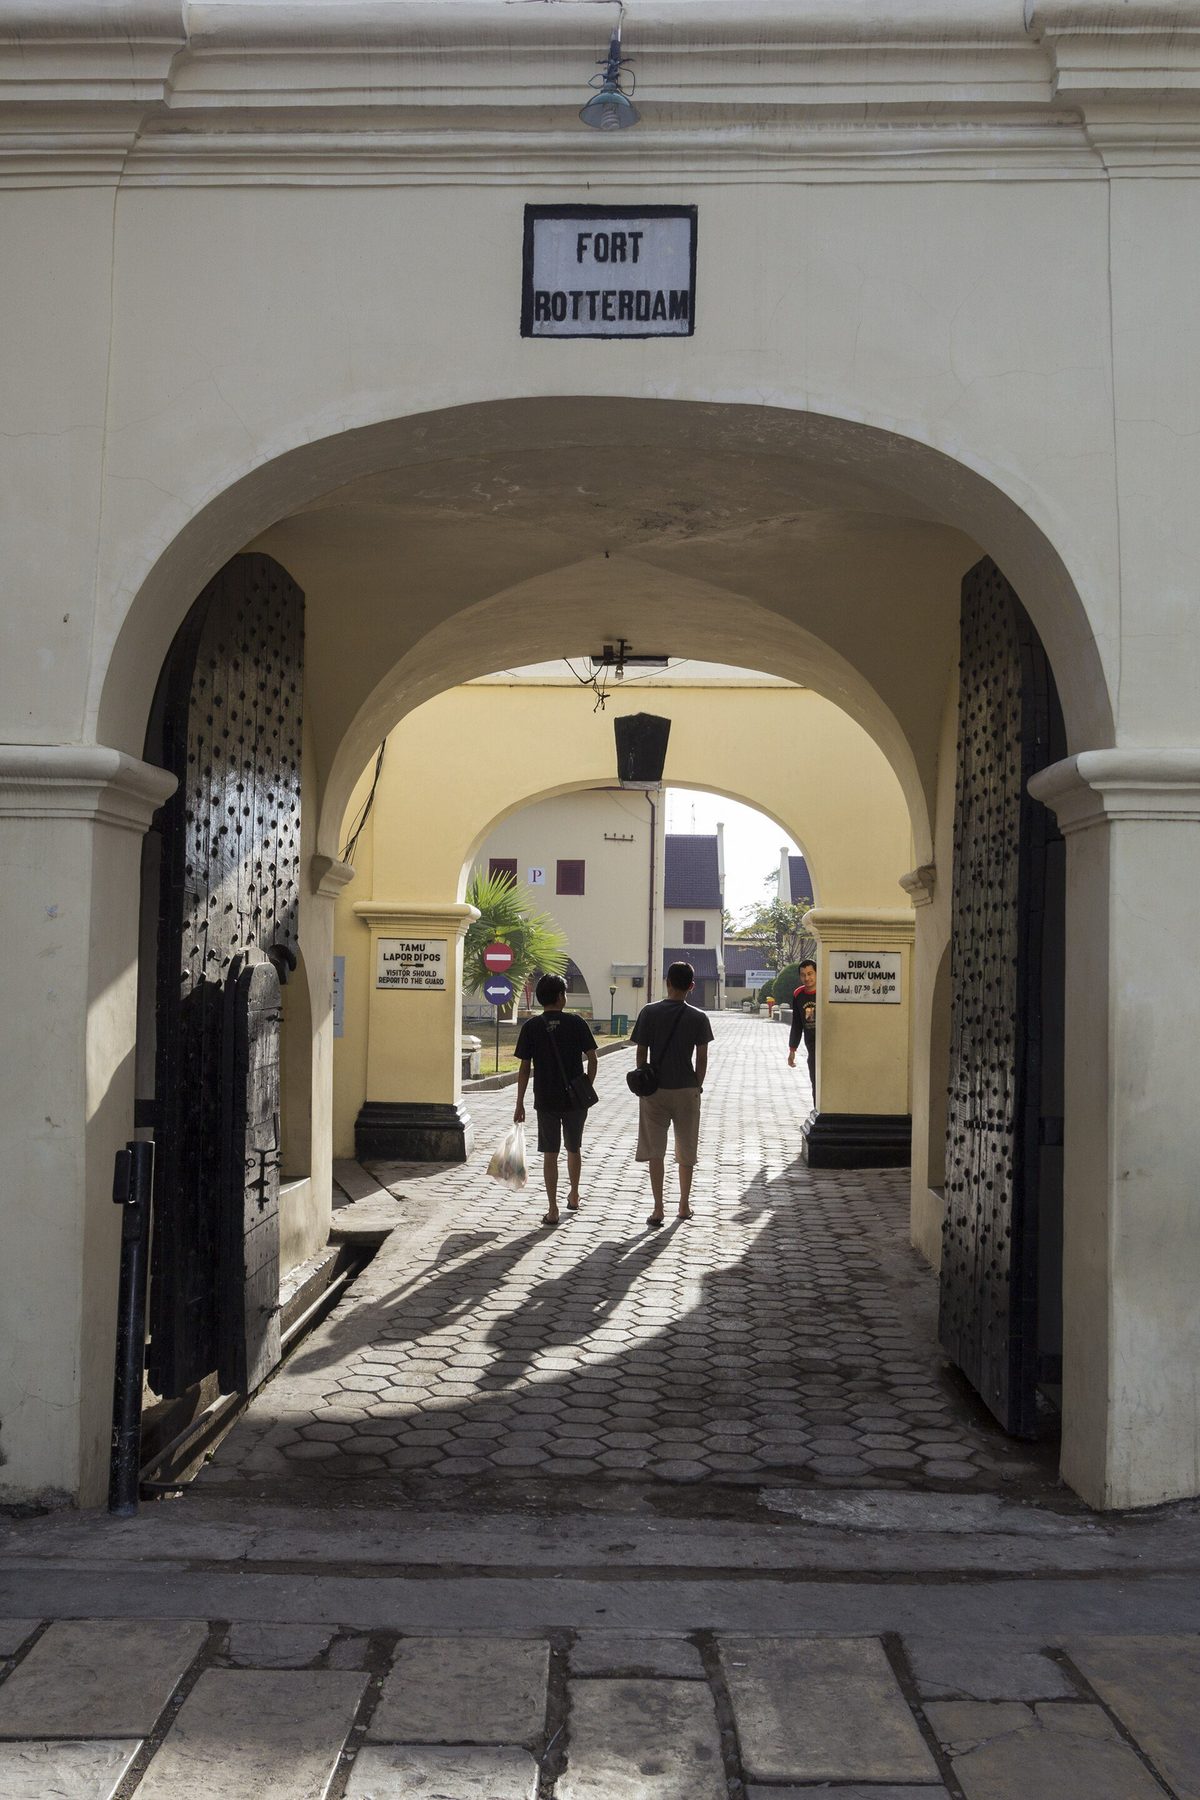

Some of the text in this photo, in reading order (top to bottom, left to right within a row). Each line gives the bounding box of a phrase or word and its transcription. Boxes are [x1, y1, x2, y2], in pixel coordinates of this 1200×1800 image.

[577, 232, 643, 263] FORT
[534, 290, 689, 321] ROTTERDAM
[533, 870, 542, 882] P
[400, 944, 426, 952] TAMU
[383, 953, 412, 961] LAPOR
[848, 960, 880, 968] DIBUKA
